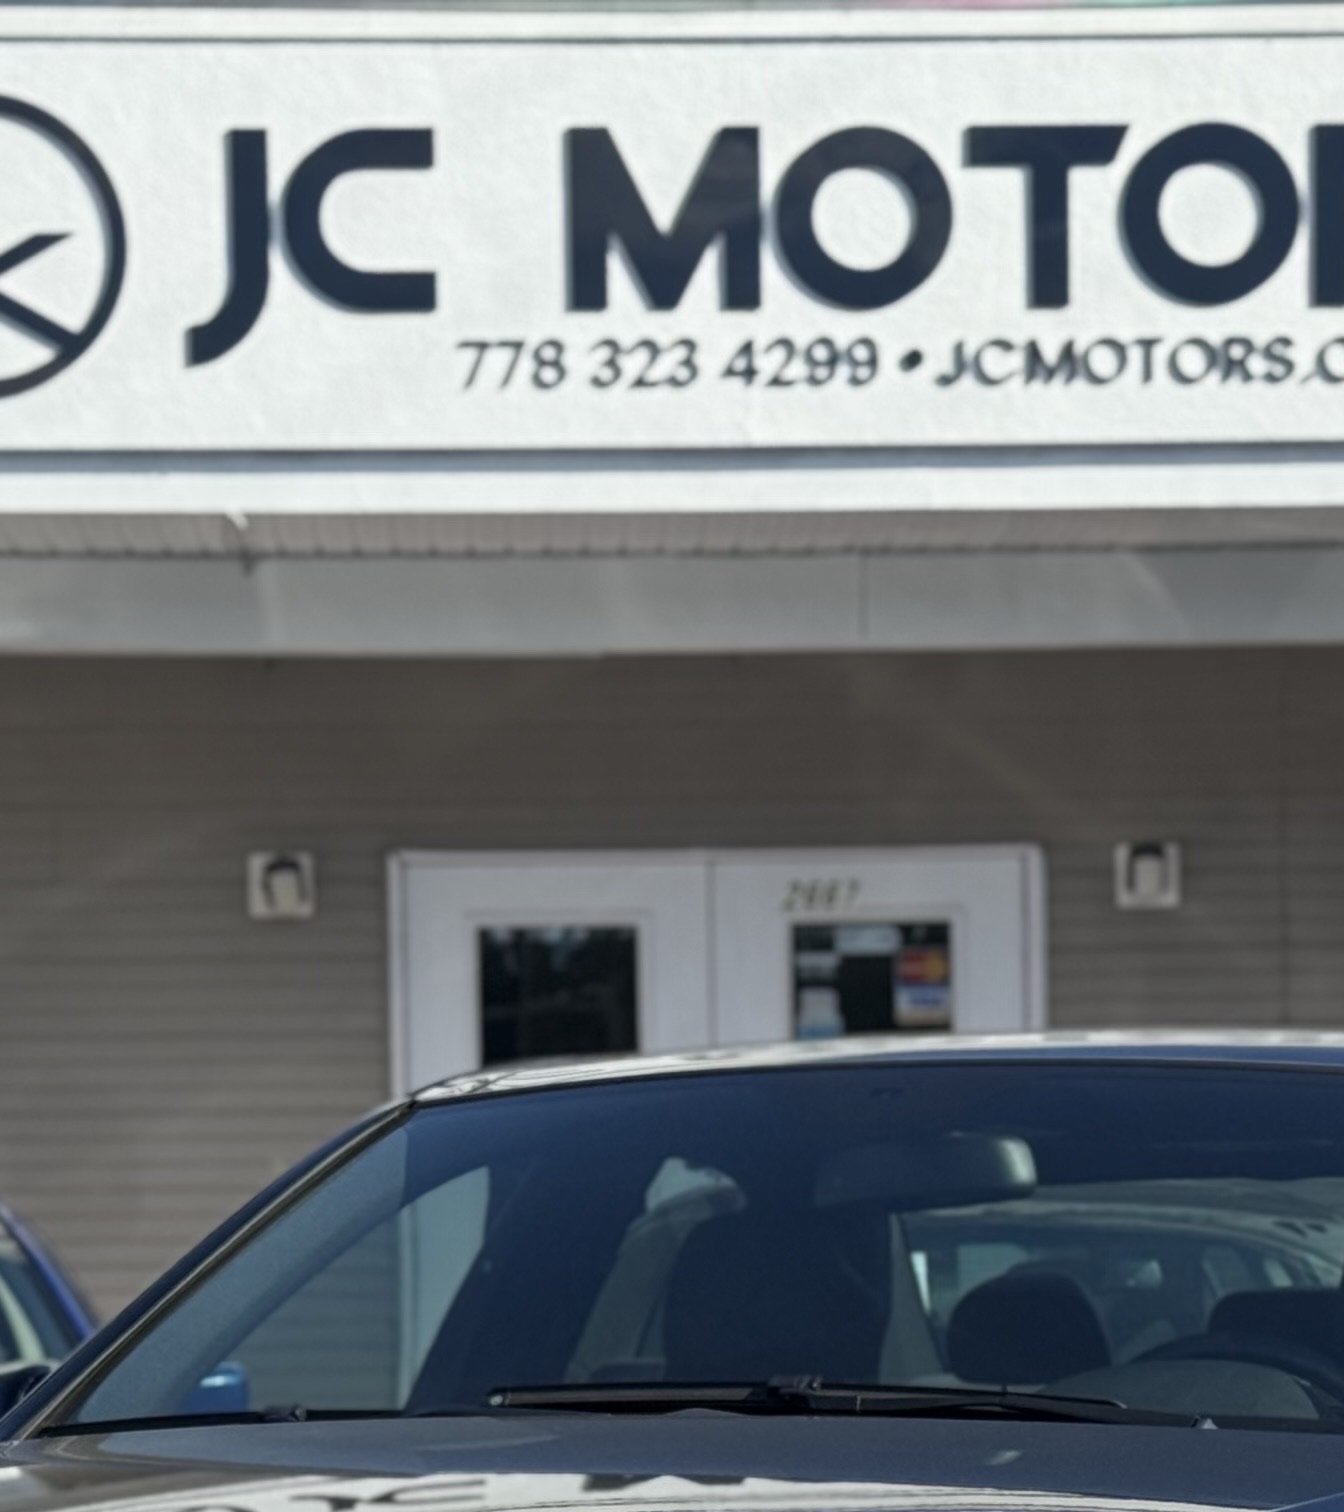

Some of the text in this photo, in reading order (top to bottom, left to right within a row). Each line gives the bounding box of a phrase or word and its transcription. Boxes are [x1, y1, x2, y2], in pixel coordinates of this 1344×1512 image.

[182, 126, 439, 369] JC
[457, 338, 568, 390] 778
[588, 337, 701, 390] 323
[721, 336, 881, 388] 4299
